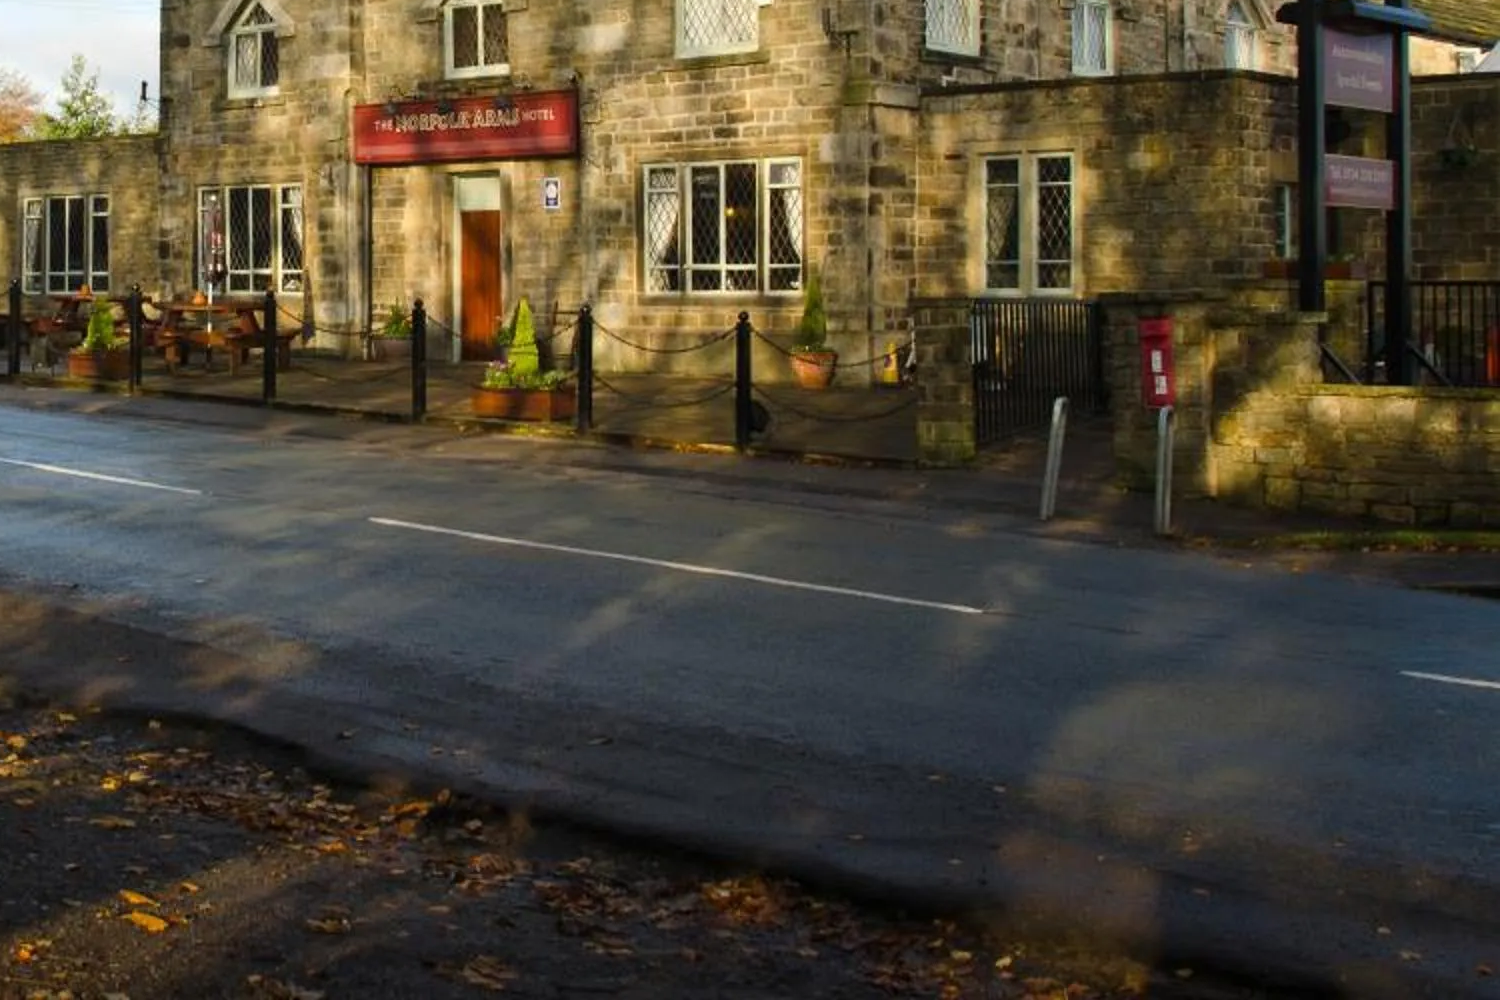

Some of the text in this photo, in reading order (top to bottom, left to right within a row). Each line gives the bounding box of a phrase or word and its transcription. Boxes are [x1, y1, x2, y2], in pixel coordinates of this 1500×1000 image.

[374, 106, 556, 132] THE NORFOLK ARMS HOTEL
